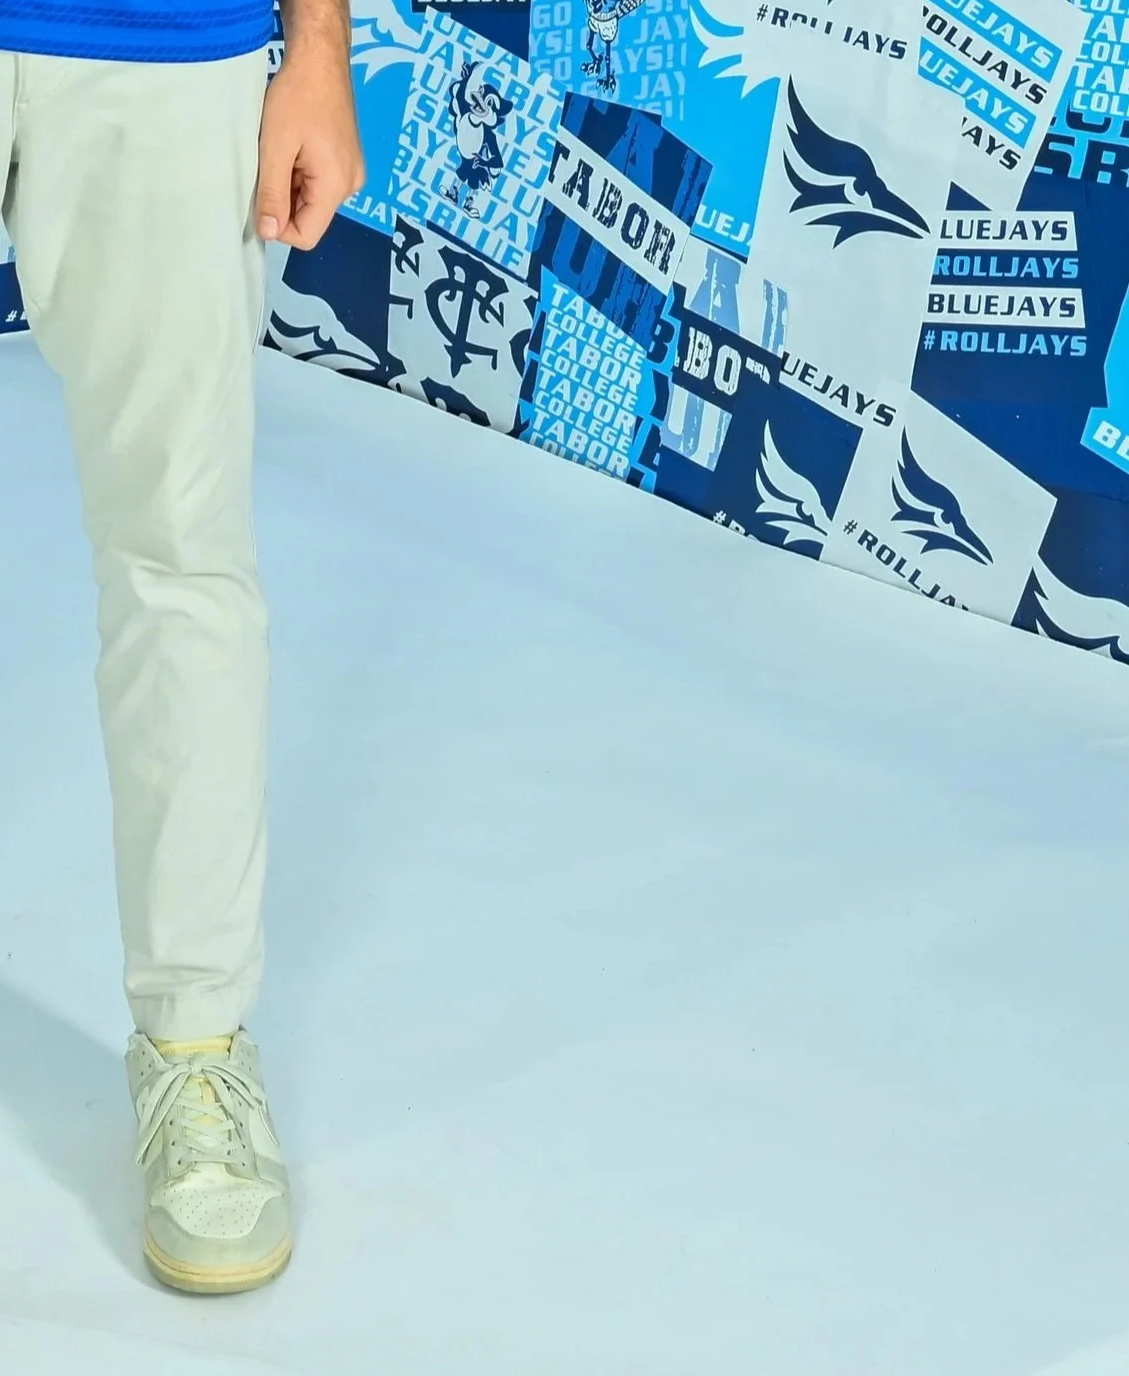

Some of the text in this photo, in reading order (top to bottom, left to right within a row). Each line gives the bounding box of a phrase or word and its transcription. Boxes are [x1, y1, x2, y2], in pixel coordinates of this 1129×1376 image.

[926, 292, 1077, 318] BLUEJAYS
[543, 326, 642, 394] TABOR
[548, 308, 647, 370] COLLEGE
[923, 329, 1087, 356] #ROLLJAYS
[538, 368, 636, 437] TABOR
[540, 348, 639, 412] COLLEGE
[531, 408, 630, 477] TABOR
[534, 390, 633, 454] COLLEGE
[842, 519, 970, 612] #ROLLJA
